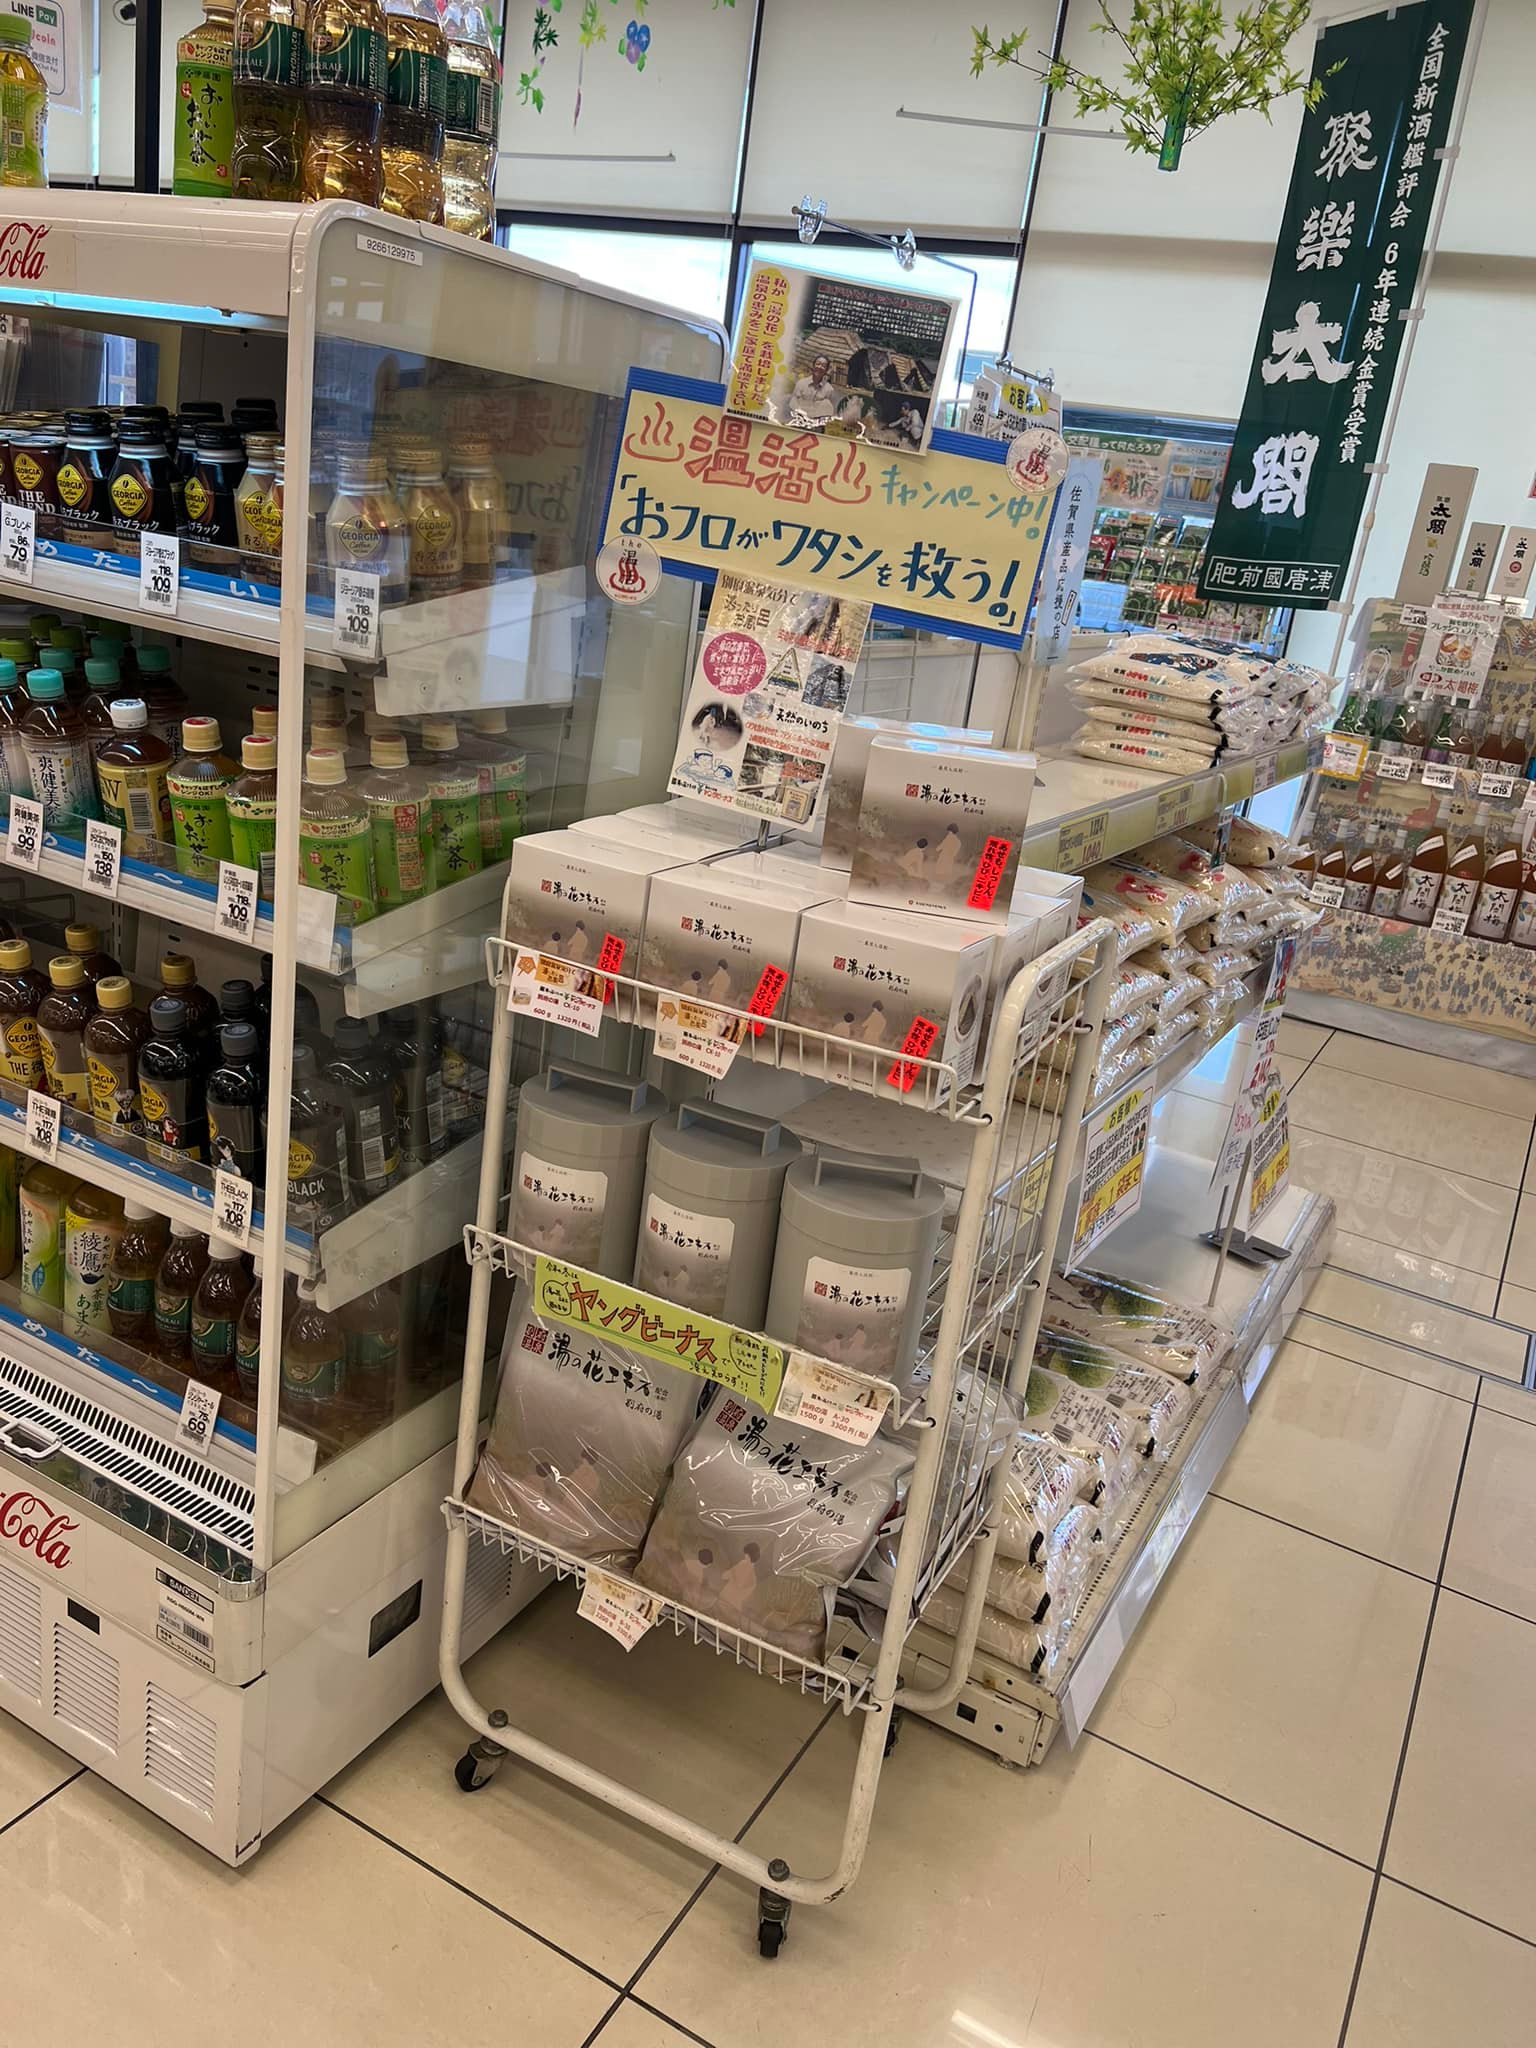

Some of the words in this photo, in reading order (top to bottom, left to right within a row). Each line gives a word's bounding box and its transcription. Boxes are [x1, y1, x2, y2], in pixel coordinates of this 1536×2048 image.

[11, 1, 34, 18] LINE
[39, 10, 55, 24] Pay
[1387, 21, 1449, 229] 全国新酒鑑評会
[0, 222, 52, 280] Cola
[366, 239, 416, 262] 9266129975
[1339, 241, 1400, 464] 6年連続金賞受賞
[684, 415, 820, 504] 温活
[19, 491, 46, 503] THE
[111, 488, 148, 502] GEORGIA
[17, 535, 28, 546] 86
[341, 529, 381, 543] GEORGIA
[10, 543, 27, 562] 79
[158, 565, 171, 577] 118
[1210, 556, 1335, 592] 肥前國唐津
[151, 575, 171, 593] 109
[355, 603, 370, 616] 118
[347, 614, 369, 634] 109
[39, 755, 61, 824] 爽健美茶
[24, 825, 36, 836] 107
[17, 834, 35, 851] 99
[94, 859, 112, 877] 138
[236, 894, 249, 905] 118
[228, 903, 248, 921] 109
[533, 1007, 546, 1016] 600
[10, 1060, 29, 1076] THE
[42, 1120, 53, 1130] 117
[36, 1126, 52, 1145] 108
[232, 1201, 245, 1212] 117
[225, 1208, 243, 1228] 108
[80, 1231, 102, 1273] 綾鷹
[570, 1281, 718, 1364] ヤングビーナス
[547, 1332, 653, 1397] 湯の花エキス
[800, 1410, 818, 1421] 1500
[187, 1417, 206, 1435] 69
[0, 1491, 80, 1570] Cola
